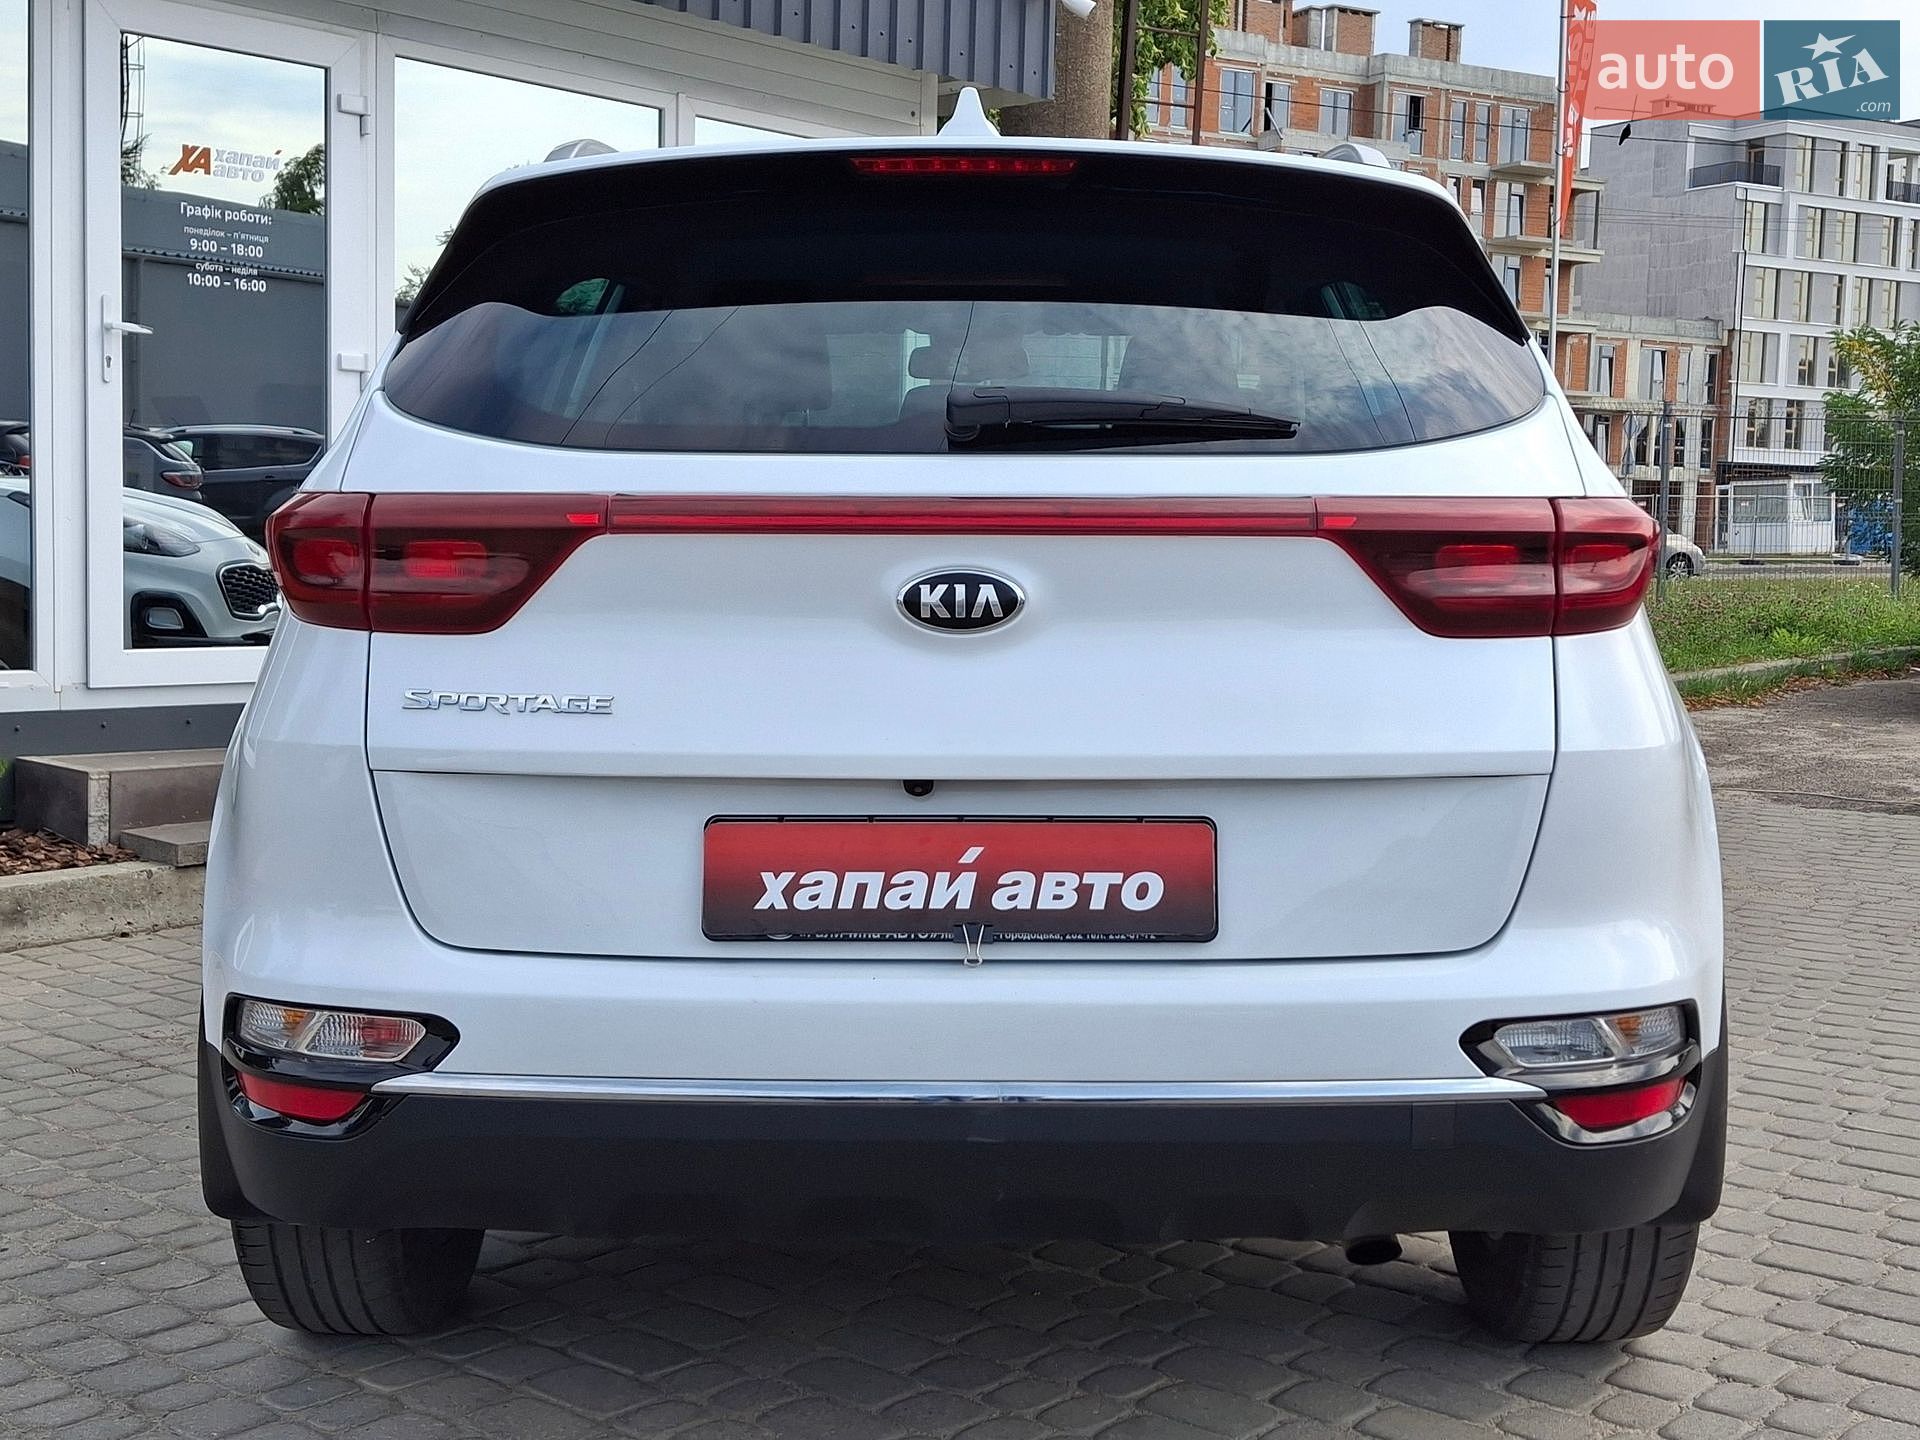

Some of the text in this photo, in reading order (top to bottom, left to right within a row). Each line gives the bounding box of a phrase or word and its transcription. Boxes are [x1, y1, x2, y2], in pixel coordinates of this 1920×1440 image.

[213, 165, 265, 182] авто
[180, 201, 272, 225] Графік роботи:
[183, 226, 225, 238] понеділок
[189, 238, 217, 253] 9:00
[230, 243, 263, 258] 18:00
[195, 262, 223, 272] субота
[231, 266, 258, 276] неділя
[187, 272, 221, 288] 10:00
[233, 277, 267, 292] 16:00
[919, 583, 1004, 619] KIA
[401, 688, 614, 716] SPORTAGE
[753, 846, 1165, 912] хапай авто
